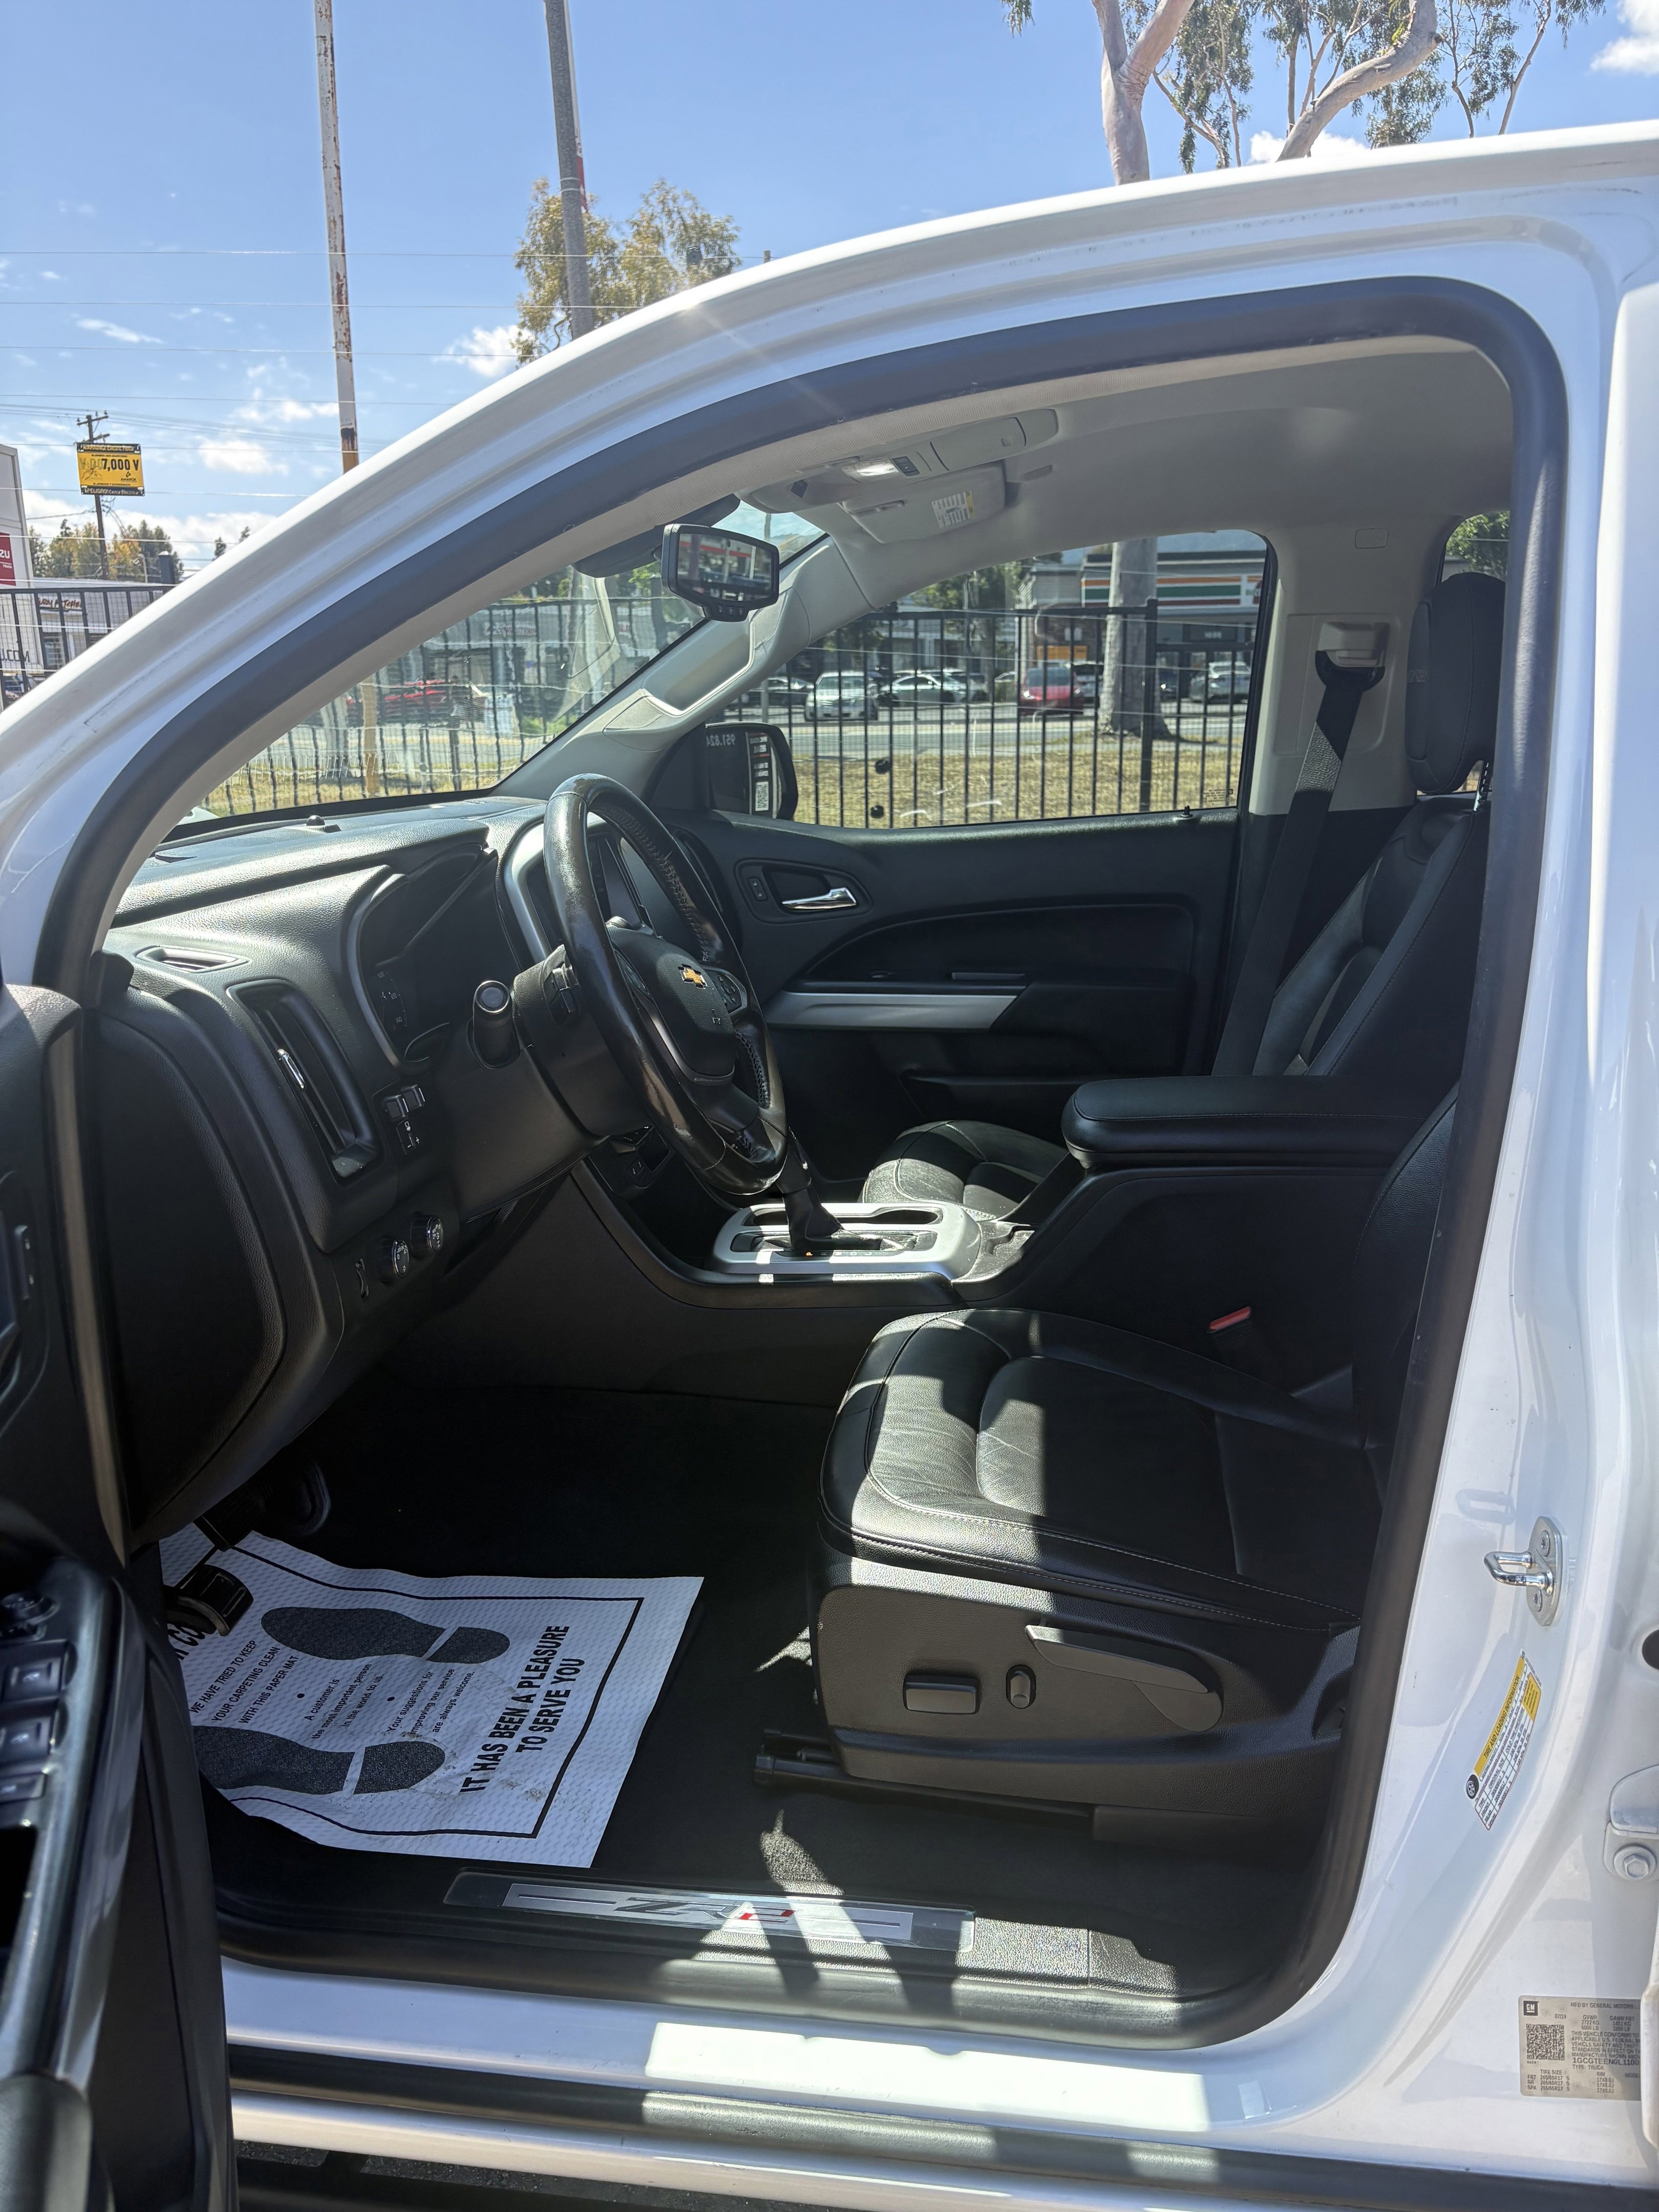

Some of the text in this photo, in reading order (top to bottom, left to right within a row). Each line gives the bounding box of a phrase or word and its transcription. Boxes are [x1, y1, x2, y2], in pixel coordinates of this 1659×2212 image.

[101, 458, 139, 471] 7,000 V
[189, 1640, 257, 1713] WE HAVE TRIED TO KEEP
[211, 1647, 281, 1721] YOUR CARPETING CLEAN
[239, 1655, 299, 1724] WITH THIS PAPER MAT
[311, 1685, 335, 1713] customer
[311, 1664, 372, 1739] the most important person
[346, 1710, 359, 1719] the
[355, 1692, 372, 1709] world
[373, 1674, 385, 1683] us.
[386, 1716, 403, 1732] Your
[399, 1680, 428, 1716] suggestions
[408, 1669, 455, 1734] improving our service
[432, 1671, 475, 1733] are always welcome.
[515, 1658, 585, 1753] TO SERVE YOU
[459, 1626, 570, 1793] IT HAS BEEN A PLEASURE
[1483, 1743, 1492, 1759] TIRE
[1495, 1711, 1507, 1736] LOADING
[1504, 1674, 1520, 1712] INFORMATION
[1481, 1802, 1490, 1817] FRONT
[1488, 1769, 1499, 1789] ORIGINAL
[614, 1897, 797, 1923] ZR2
[1526, 2003, 1535, 2012] GM
